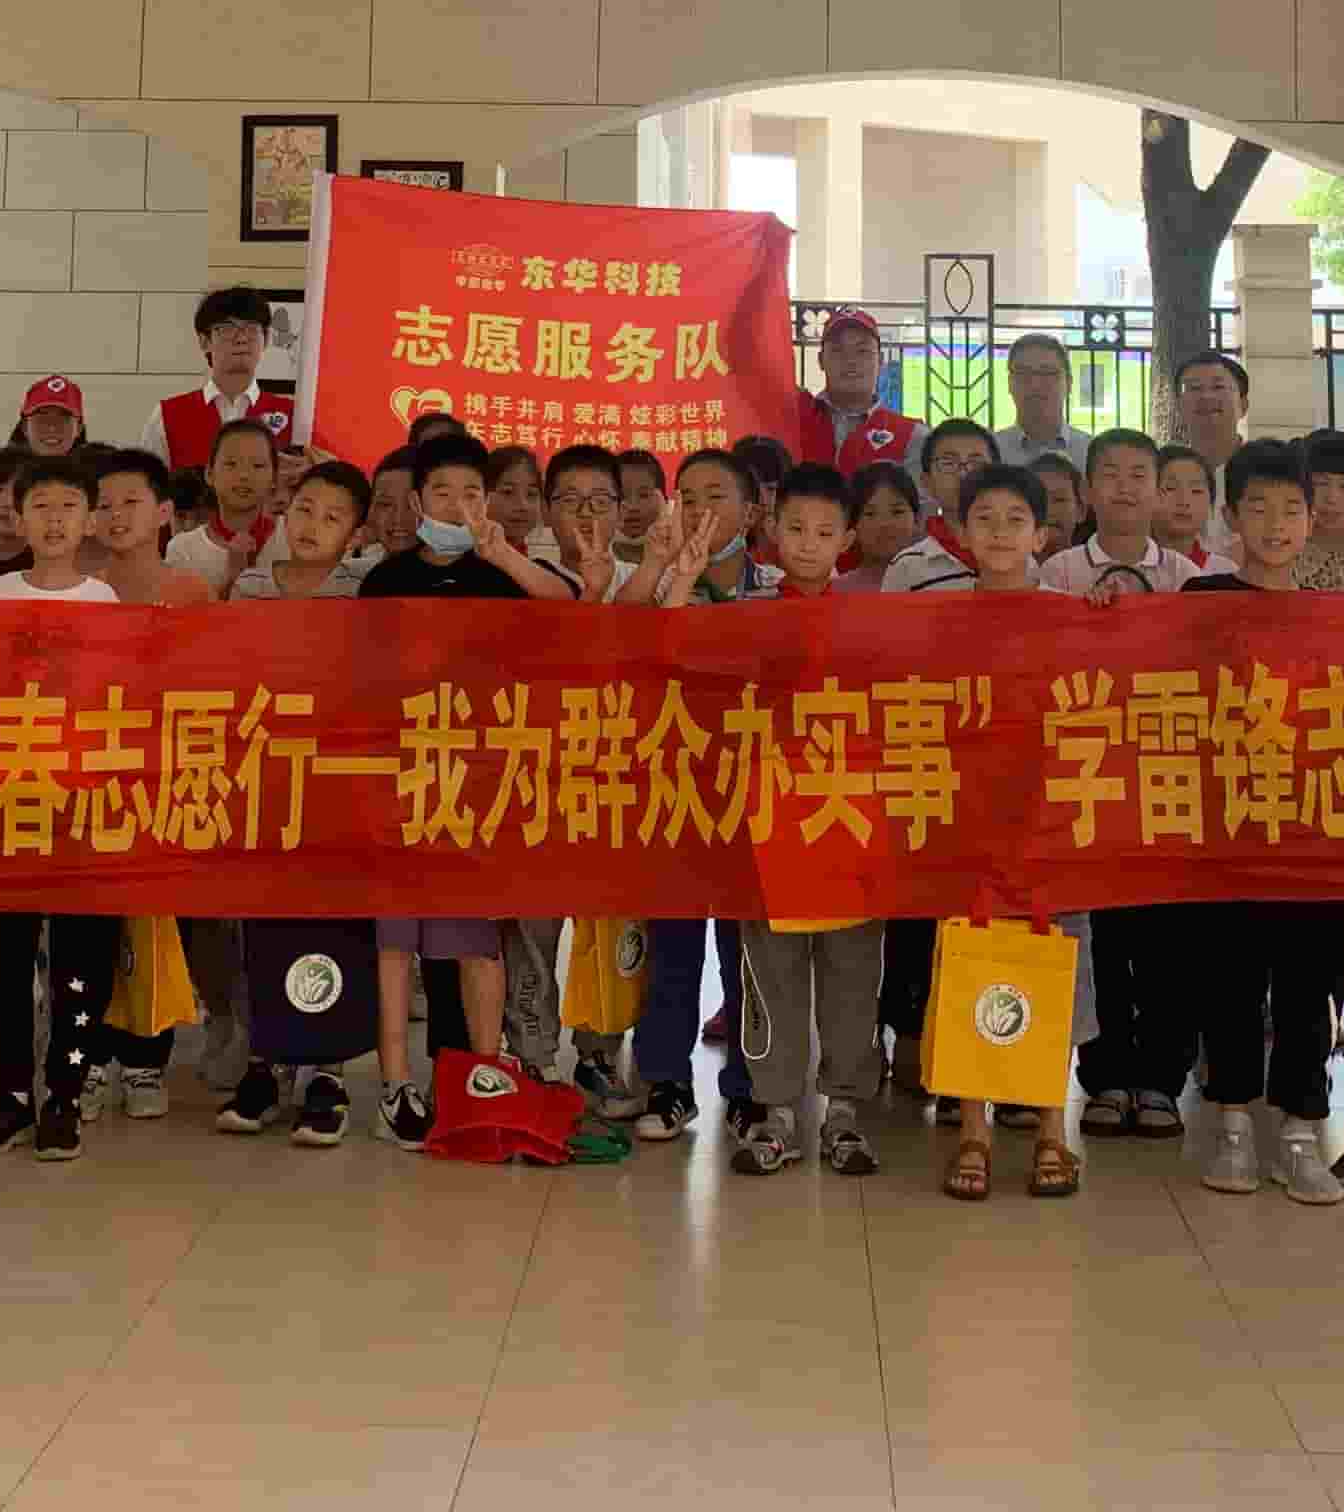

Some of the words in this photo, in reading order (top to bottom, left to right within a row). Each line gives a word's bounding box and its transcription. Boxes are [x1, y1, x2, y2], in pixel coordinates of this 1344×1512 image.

[521, 256, 683, 297] 东华科技
[391, 303, 730, 384] 志愿服务队
